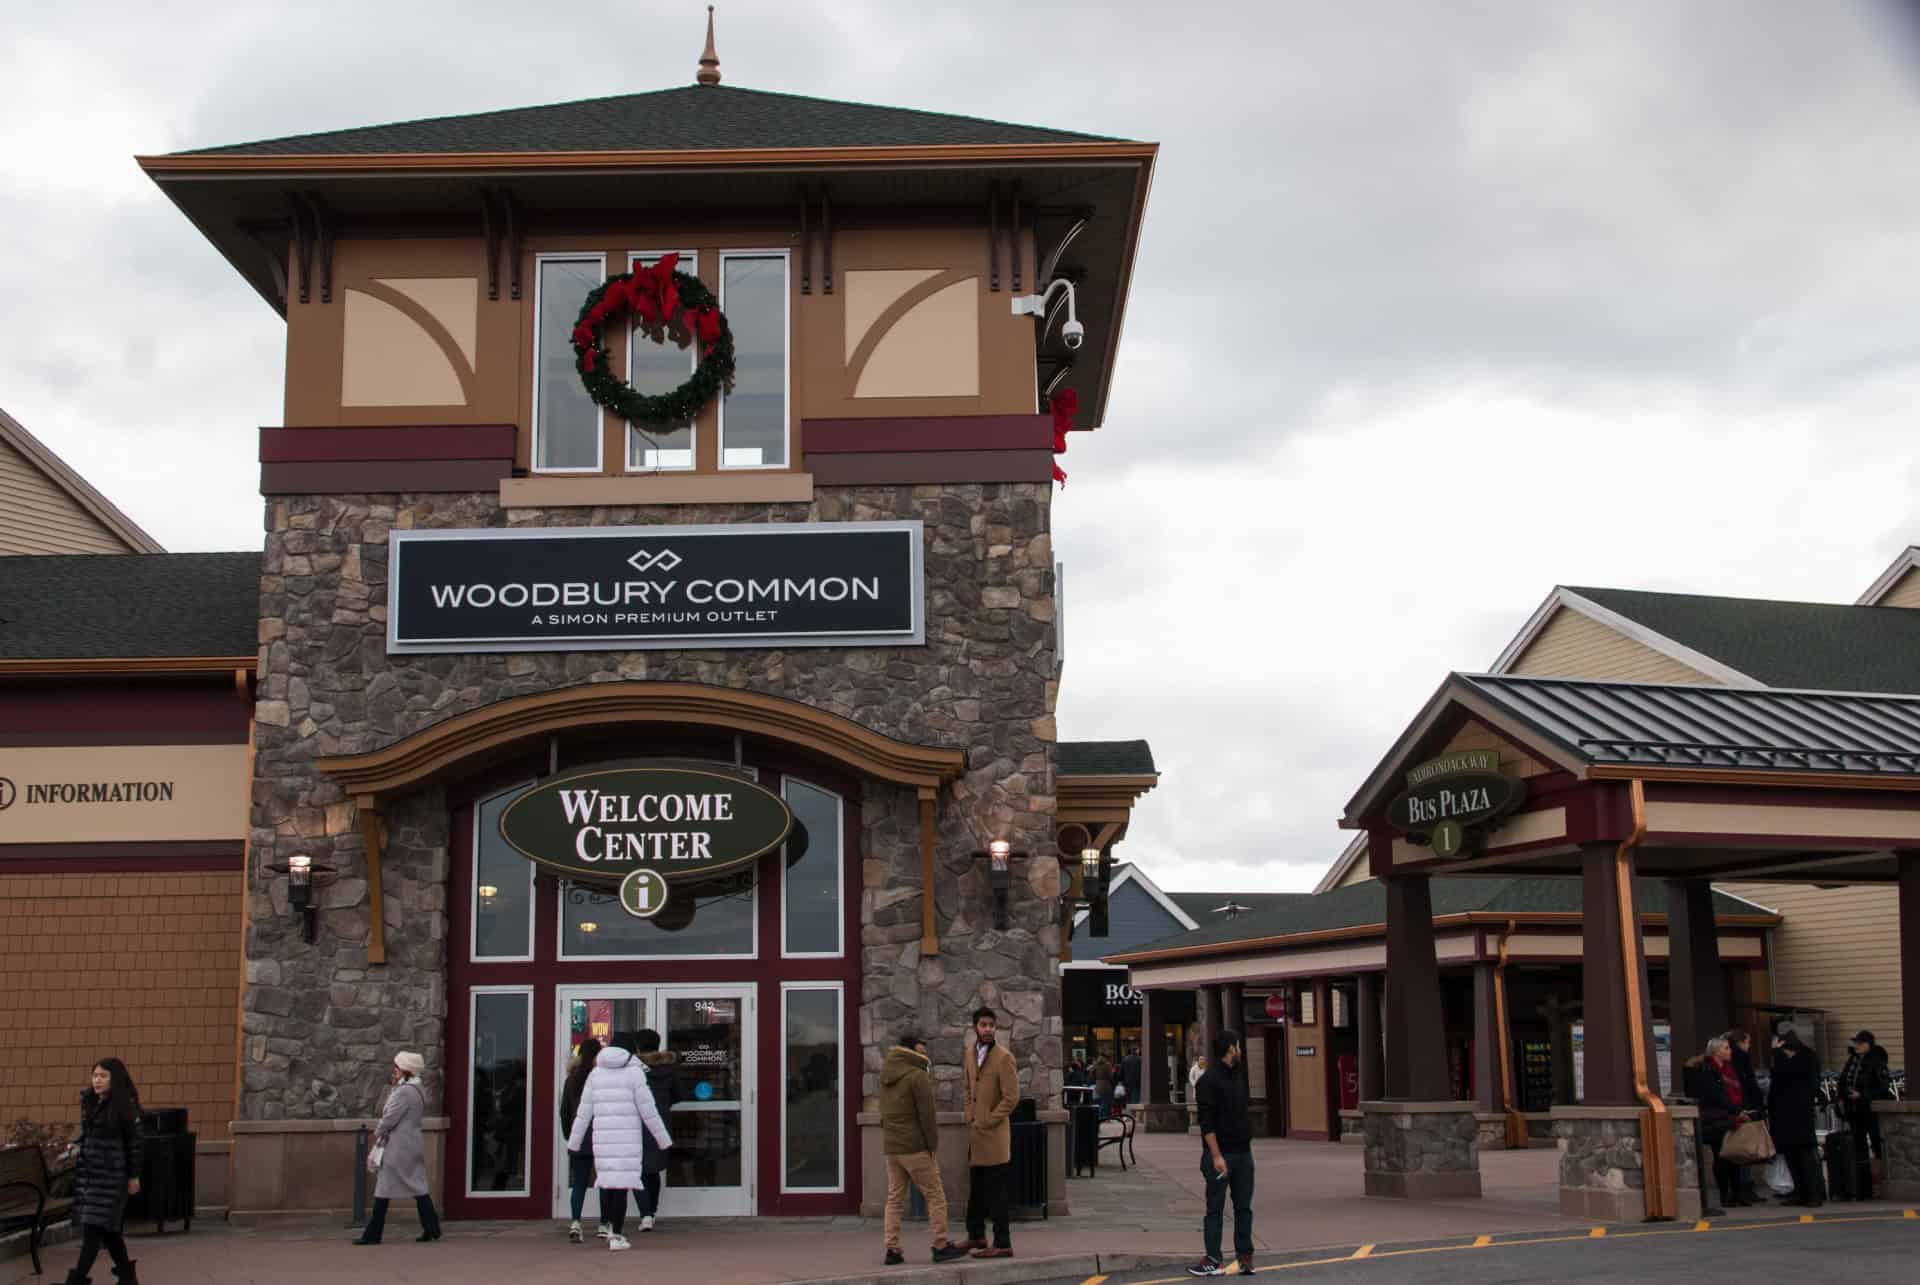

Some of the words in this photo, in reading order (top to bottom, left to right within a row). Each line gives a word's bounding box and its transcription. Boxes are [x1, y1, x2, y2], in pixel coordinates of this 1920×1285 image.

[431, 580, 676, 608] WOODBURY
[686, 576, 880, 604] COMMON
[531, 615, 543, 625] A
[549, 613, 608, 625] SIMON
[615, 611, 700, 624] PREMIUM
[707, 610, 778, 622] OUTLET
[27, 782, 174, 804] INFORMATION
[559, 789, 734, 824] WELCOME
[576, 826, 712, 862] CENTER
[1106, 984, 1144, 1000] BOS
[694, 1001, 715, 1013] 942
